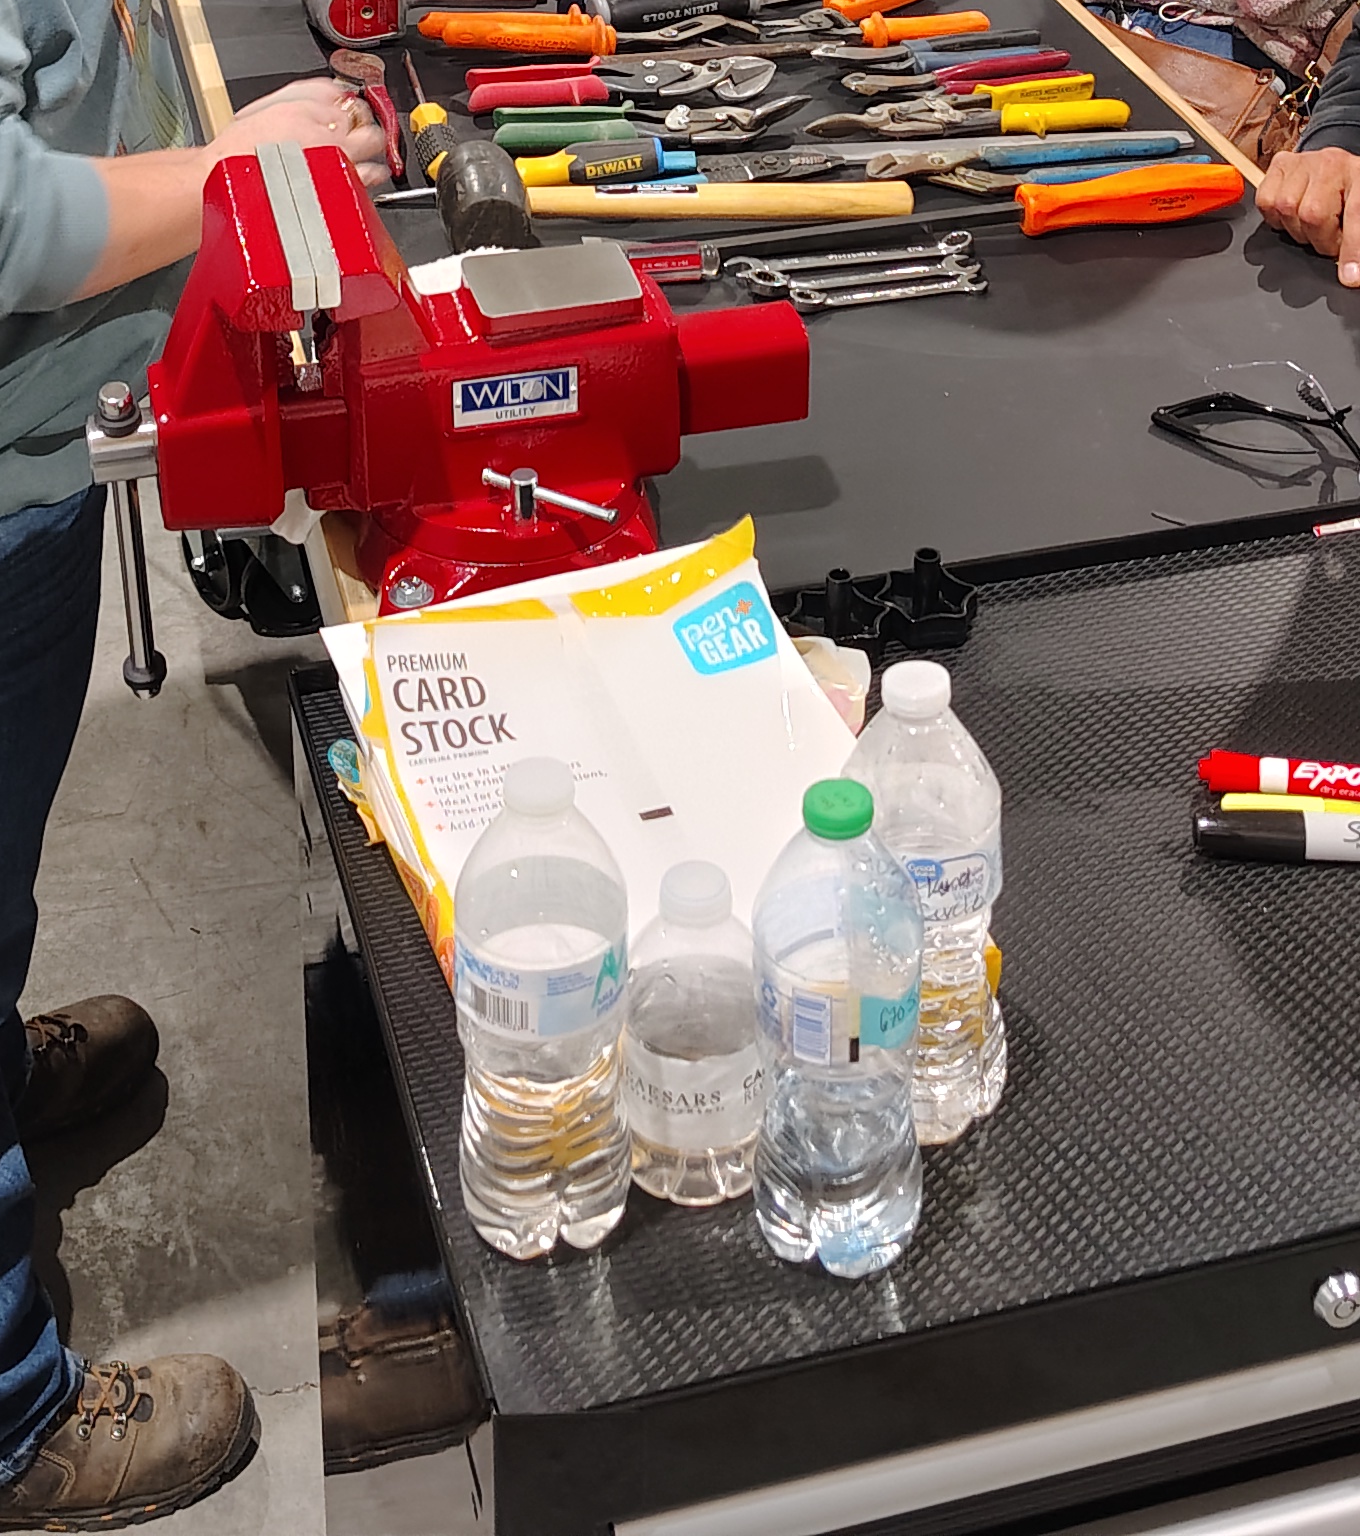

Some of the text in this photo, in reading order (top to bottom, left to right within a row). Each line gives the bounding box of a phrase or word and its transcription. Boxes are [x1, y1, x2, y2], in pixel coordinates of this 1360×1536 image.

[642, 1, 719, 22] KLEIN TOOLS
[467, 374, 563, 409] WILTON
[495, 406, 536, 420] UTILITY
[698, 617, 769, 666] GEAR
[386, 652, 468, 673] PREMIUM
[392, 675, 487, 713] CARD
[400, 712, 517, 756] STOCK
[429, 774, 448, 786] For
[453, 769, 475, 781] Use
[1319, 786, 1337, 797] dry
